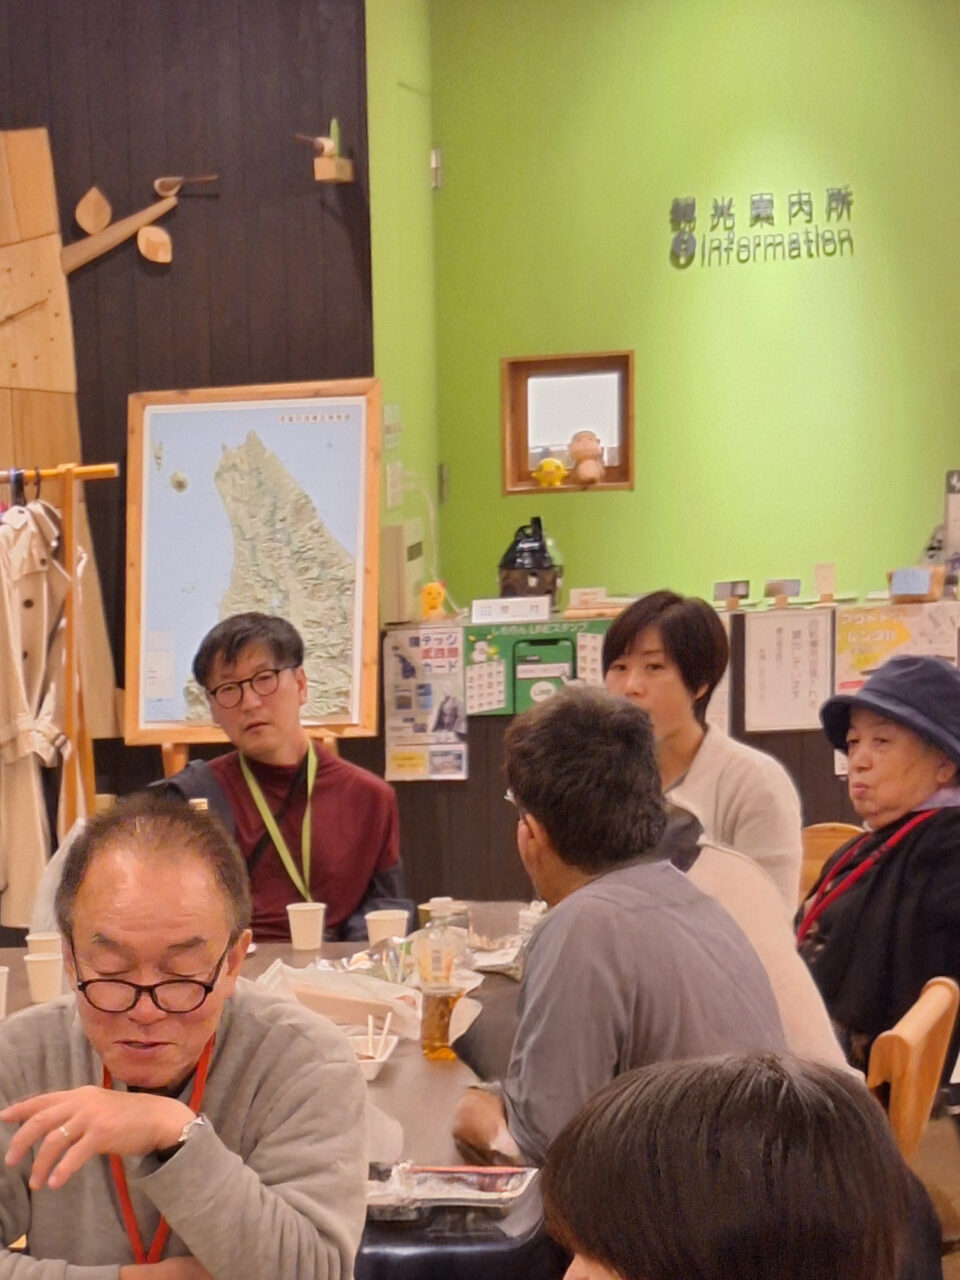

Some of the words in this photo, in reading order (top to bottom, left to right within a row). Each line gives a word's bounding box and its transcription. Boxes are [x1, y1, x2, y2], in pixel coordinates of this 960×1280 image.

[671, 186, 854, 231] 観光案内所
[701, 226, 854, 267] Information
